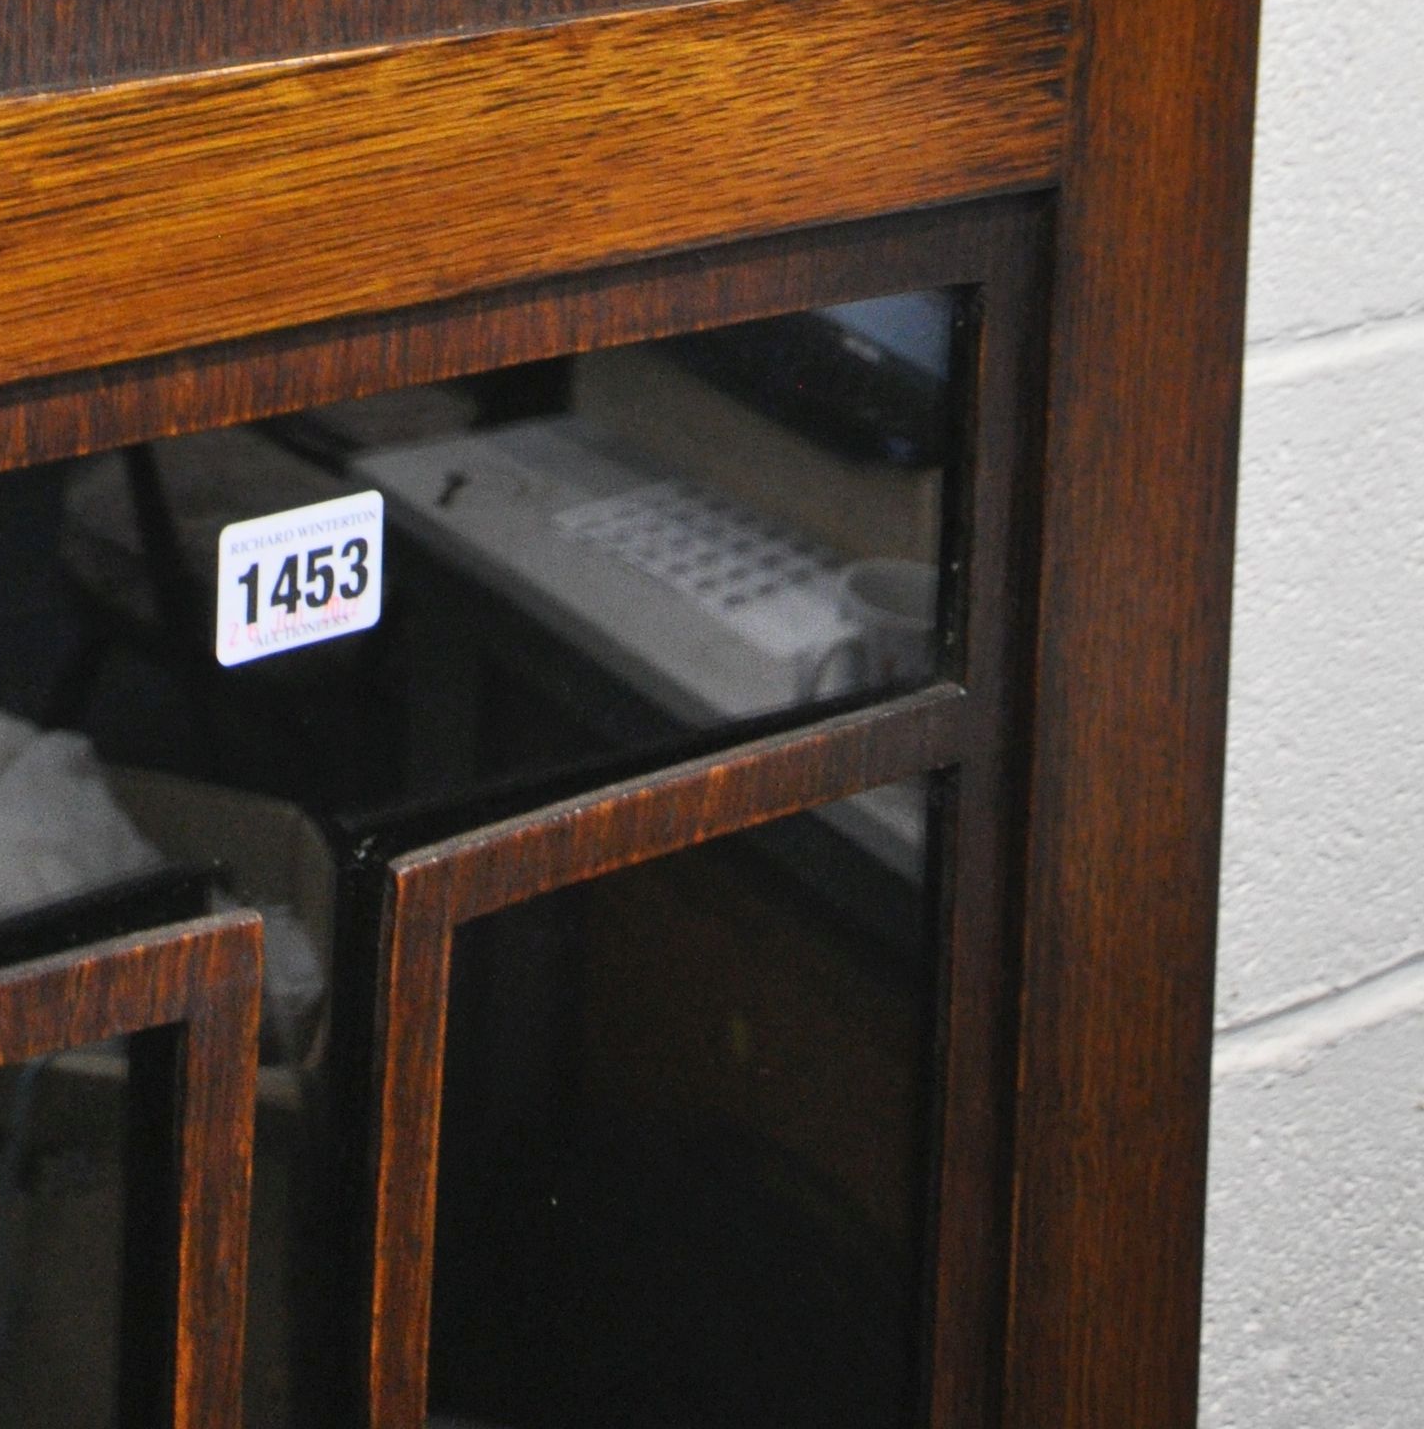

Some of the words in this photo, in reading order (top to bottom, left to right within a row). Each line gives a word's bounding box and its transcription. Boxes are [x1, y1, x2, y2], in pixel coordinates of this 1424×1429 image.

[230, 529, 294, 556] RICHARD
[296, 509, 378, 539] WINTERTON
[237, 537, 369, 626] 1453
